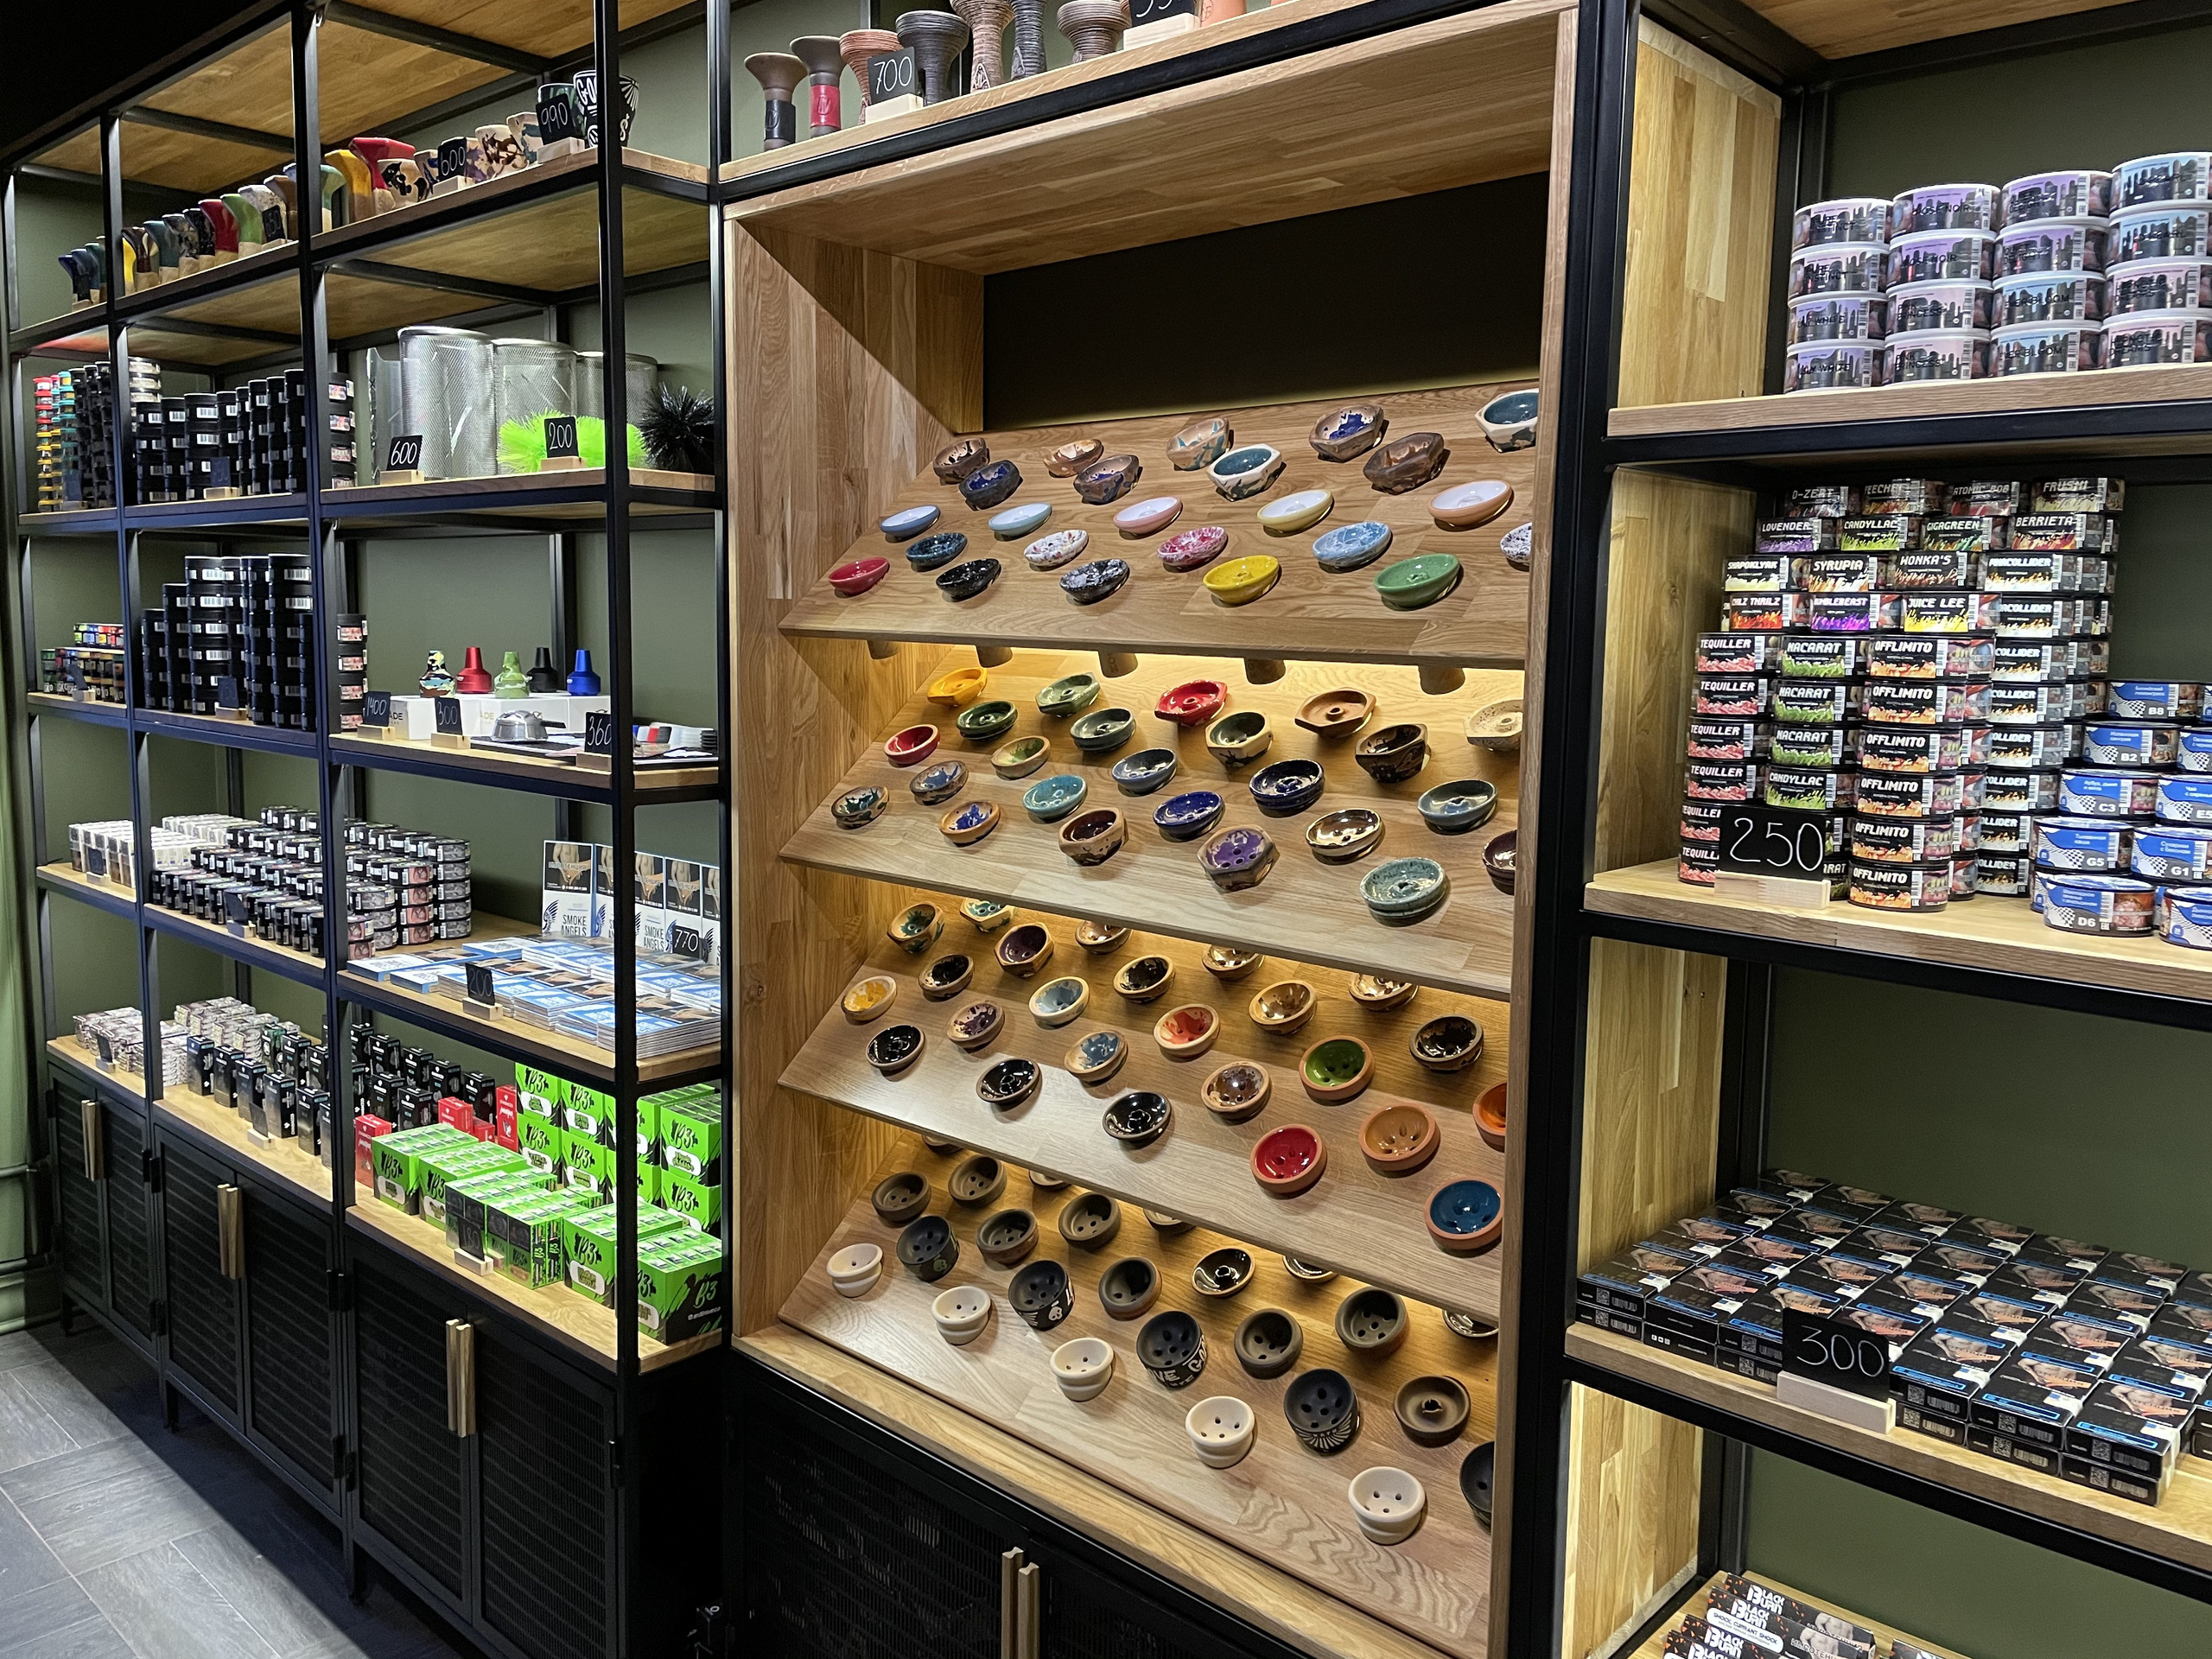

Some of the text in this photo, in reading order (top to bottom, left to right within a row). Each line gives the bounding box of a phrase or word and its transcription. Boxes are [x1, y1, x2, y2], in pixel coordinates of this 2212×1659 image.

[874, 55, 912, 93] 700
[541, 102, 568, 132] 990
[441, 147, 466, 176] 600
[548, 422, 573, 450] 200
[391, 441, 417, 467] 600
[1844, 520, 1899, 530] CANDYLLAC
[1927, 521, 1981, 531] GIGAGREEN
[2016, 516, 2075, 527] BERRIETA
[1813, 560, 1864, 571] SYRUPIA
[1900, 555, 1952, 566] WONKA'S
[1908, 597, 1965, 608] JUICE LEE
[1700, 639, 1752, 649] TEQUILLER
[1788, 642, 1842, 654] NACARAT
[1875, 641, 1933, 653] OFFLIMITO
[1700, 682, 1756, 692] TEQUILLER
[1780, 687, 1832, 699] NACARAT
[1872, 686, 1933, 700] OFFLIMITO
[366, 696, 387, 717] 1400
[2148, 707, 2164, 715] B8
[437, 701, 459, 726] 300
[1690, 724, 1741, 735] TEQUILLER
[1777, 730, 1829, 743] NACARAT
[1866, 734, 1926, 748] OFFLIMITO
[2120, 753, 2138, 762] B2
[1691, 766, 1744, 777] TEQUILLER
[1770, 772, 1824, 786] CANDYLLAC
[1861, 778, 1919, 792] OFFLIMITO
[2098, 803, 2116, 812] C3
[1855, 822, 1910, 838] OFFLIMITO
[1730, 817, 1824, 872] 250
[1682, 847, 1719, 860] TEQUILL
[2086, 857, 2105, 867] G5
[1853, 867, 1908, 885] OFFLIMITO
[2171, 866, 2190, 876] G1
[563, 914, 588, 926] SMOKE
[2078, 917, 2096, 927] D6
[644, 925, 664, 939] SMOKE
[643, 936, 665, 952] ANGELS
[675, 929, 699, 953] 770
[1796, 1325, 1885, 1377] 300
